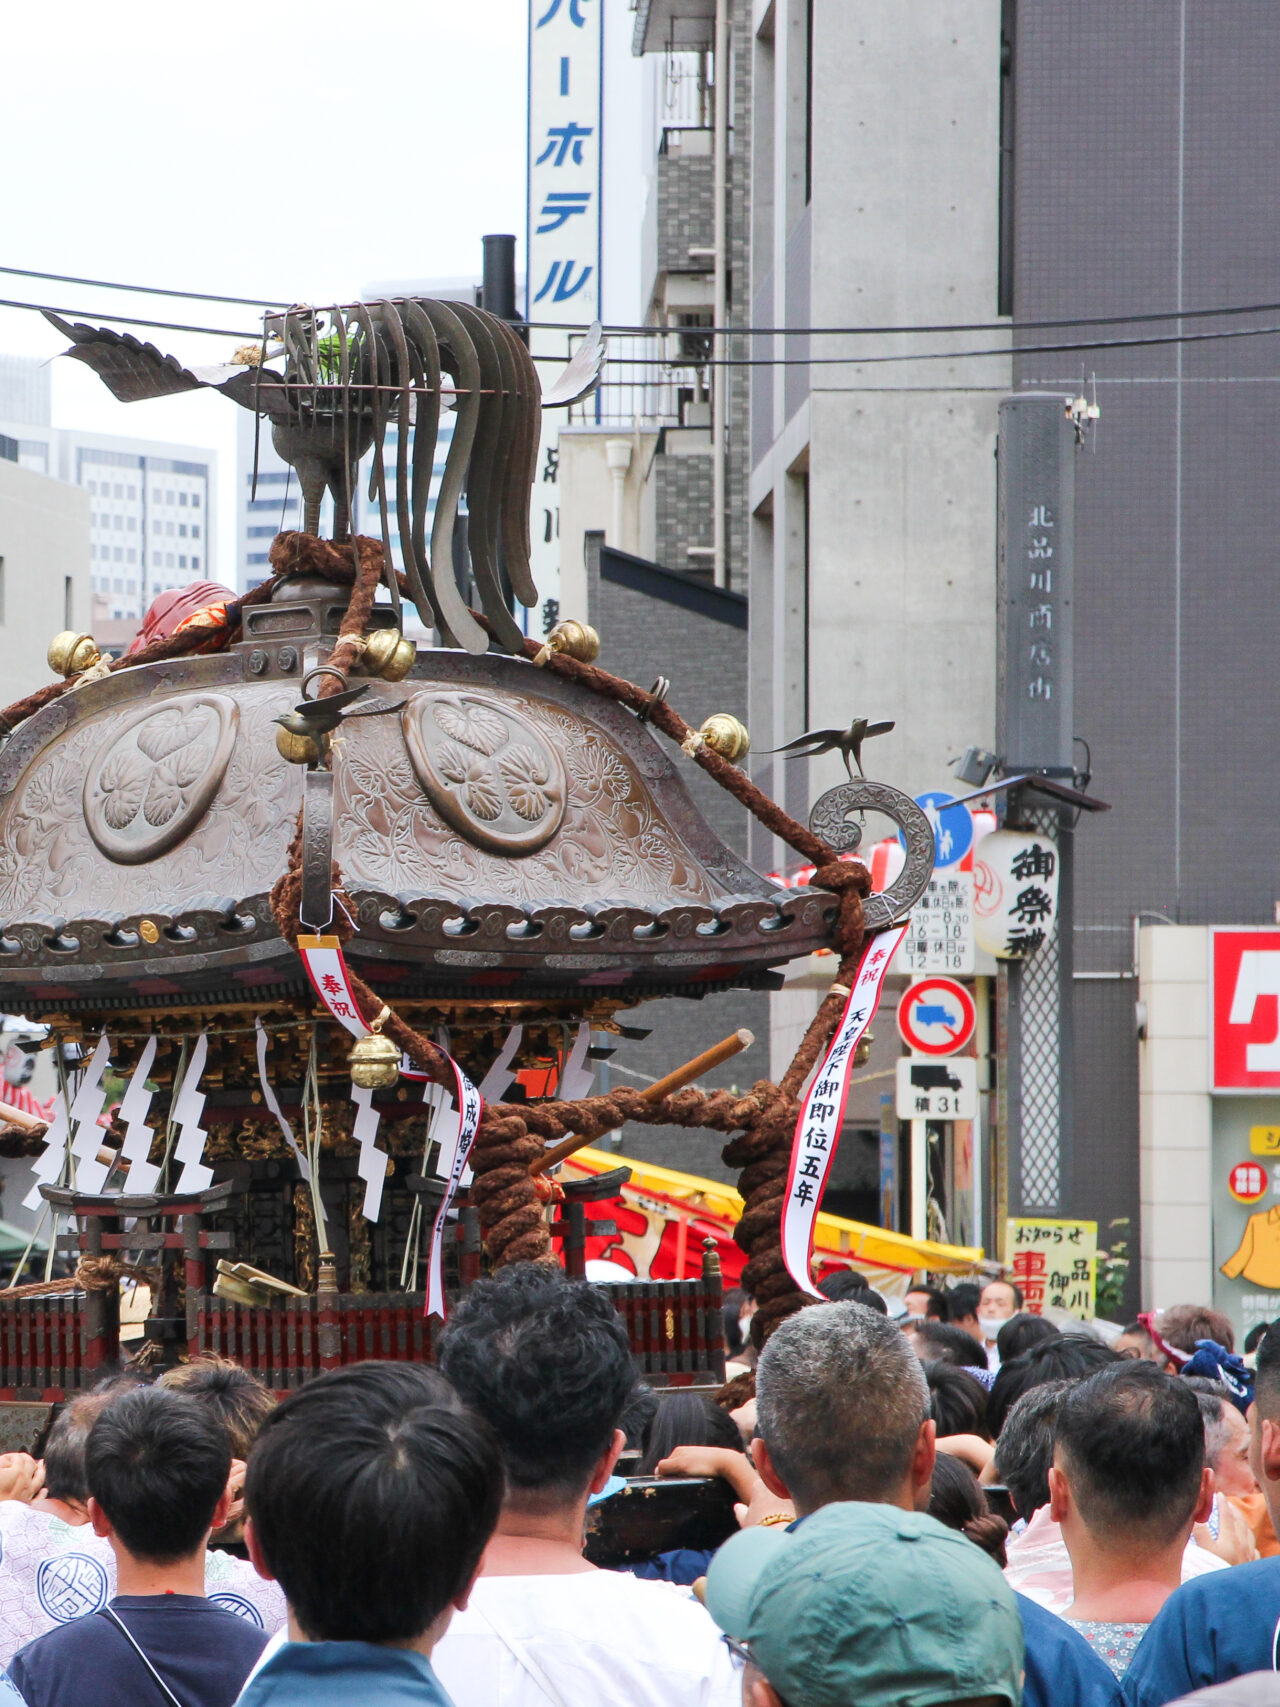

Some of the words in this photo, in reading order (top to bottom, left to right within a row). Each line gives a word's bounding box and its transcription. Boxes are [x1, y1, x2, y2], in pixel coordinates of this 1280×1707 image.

[860, 948, 887, 987] 奉祝
[321, 973, 357, 1019] 奉祝
[794, 1006, 867, 1208] 天皇陛下御即位五年
[1015, 1226, 1083, 1245] お知らせ
[1070, 1259, 1090, 1320] 品川
